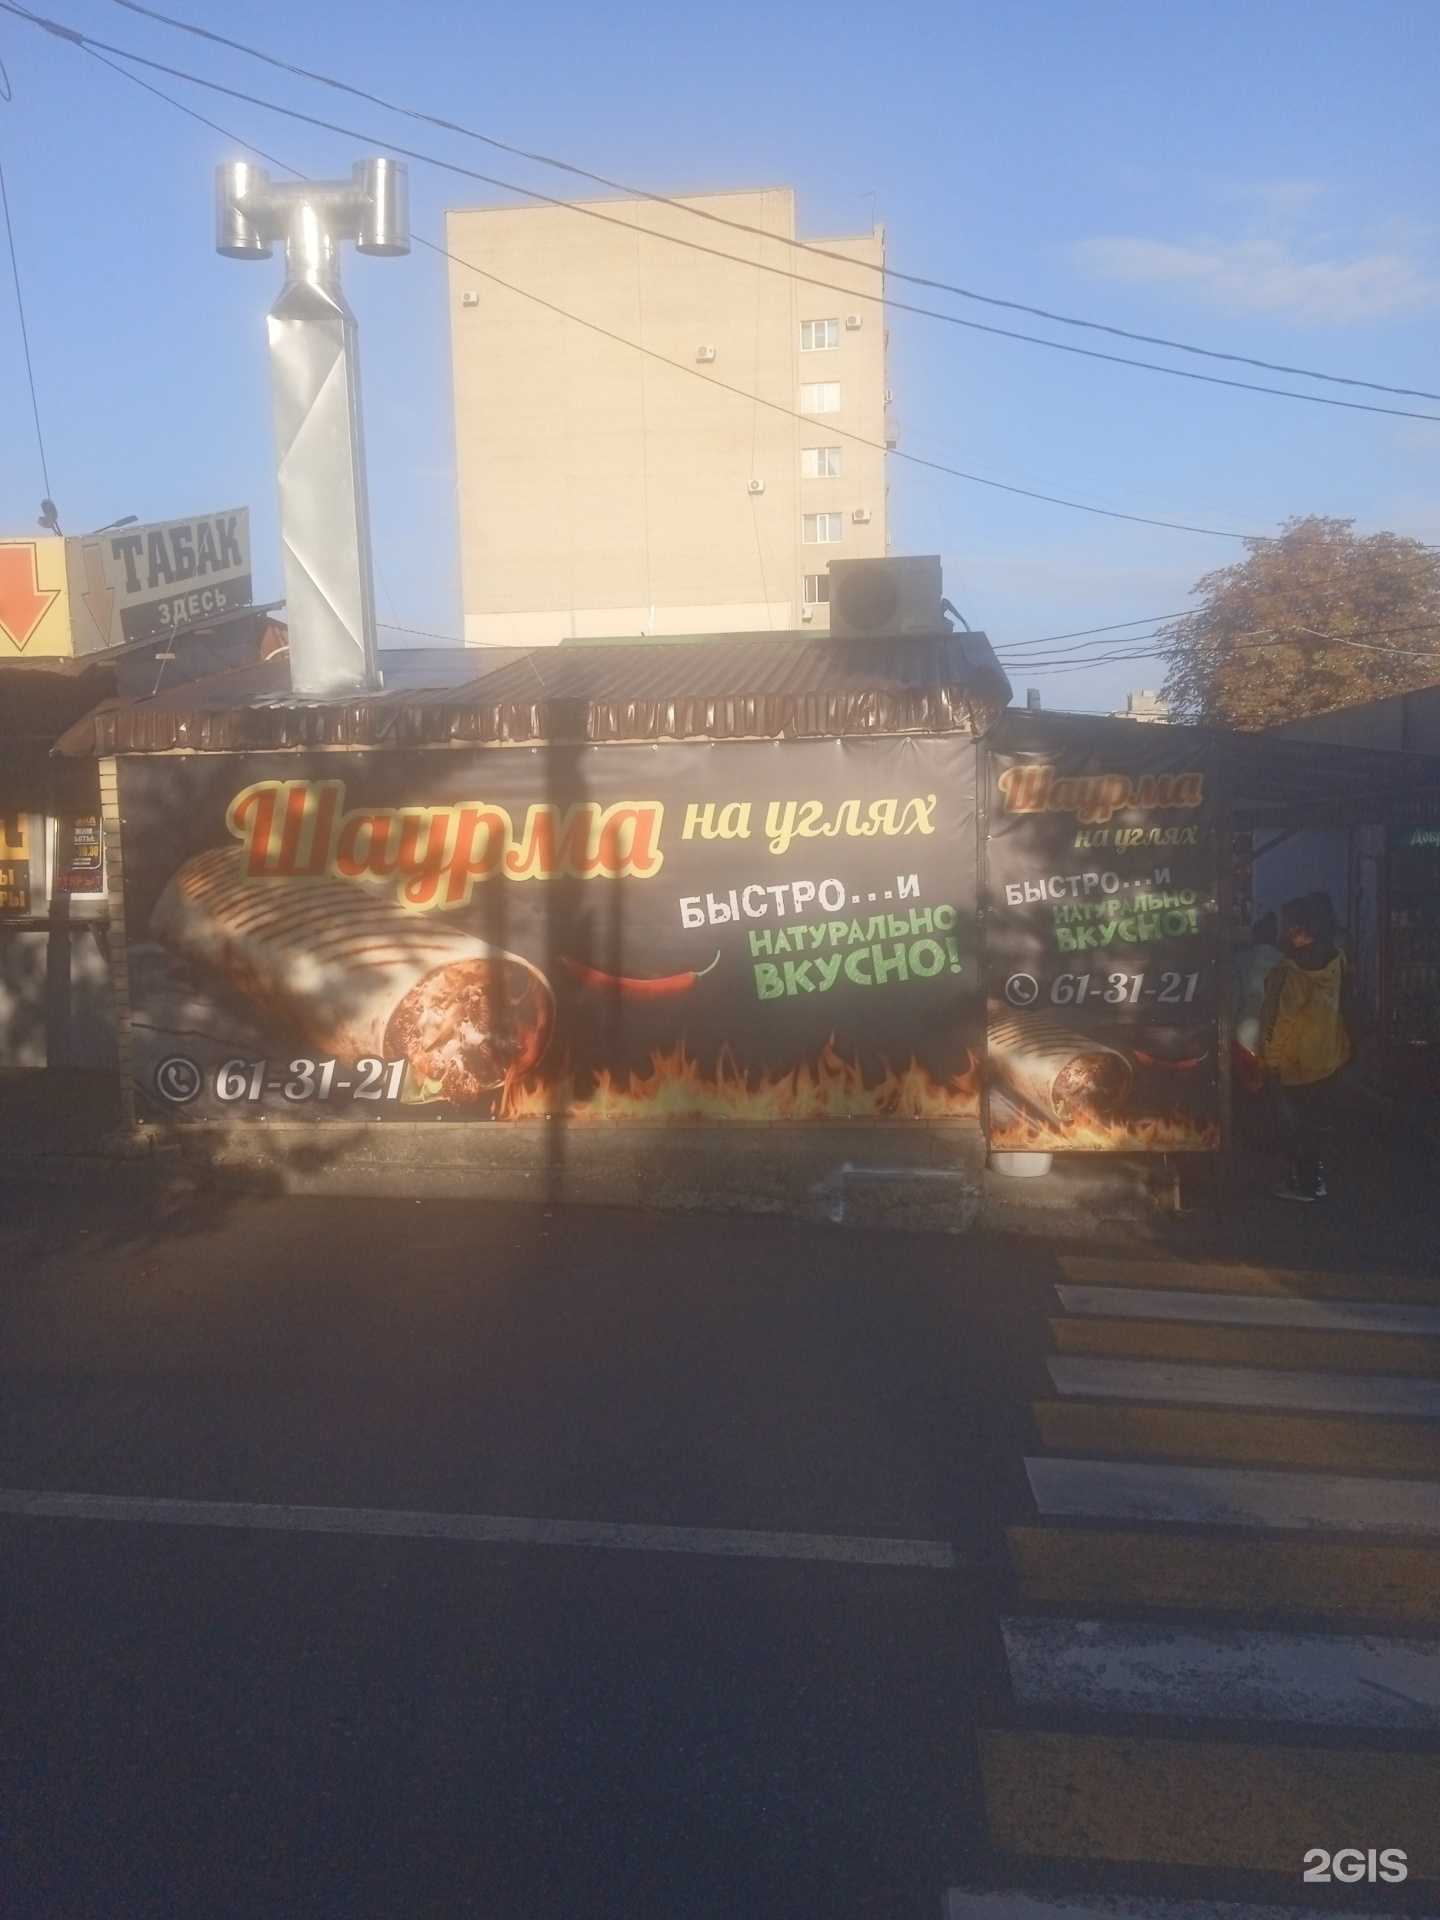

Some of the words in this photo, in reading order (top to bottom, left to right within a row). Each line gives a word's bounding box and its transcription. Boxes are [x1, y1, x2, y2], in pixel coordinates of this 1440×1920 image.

[111, 515, 242, 594] ТАБАК
[158, 589, 227, 626] ЗДЕСЬ
[998, 766, 1204, 824] Шаурма
[226, 780, 664, 911] Шаурма
[682, 802, 752, 840] на
[765, 794, 937, 855] углях
[1074, 829, 1109, 848] на
[1114, 825, 1199, 855] углях
[1054, 888, 1198, 924] НАТУРАЛЬНО
[749, 904, 957, 957] НАТУРАЛЬНО
[1055, 909, 1199, 951] ВКУСНО!
[754, 937, 962, 1000] ВКУСНО!
[1050, 972, 1200, 1004] 61-31-21
[216, 1058, 406, 1101] 61-31-21
